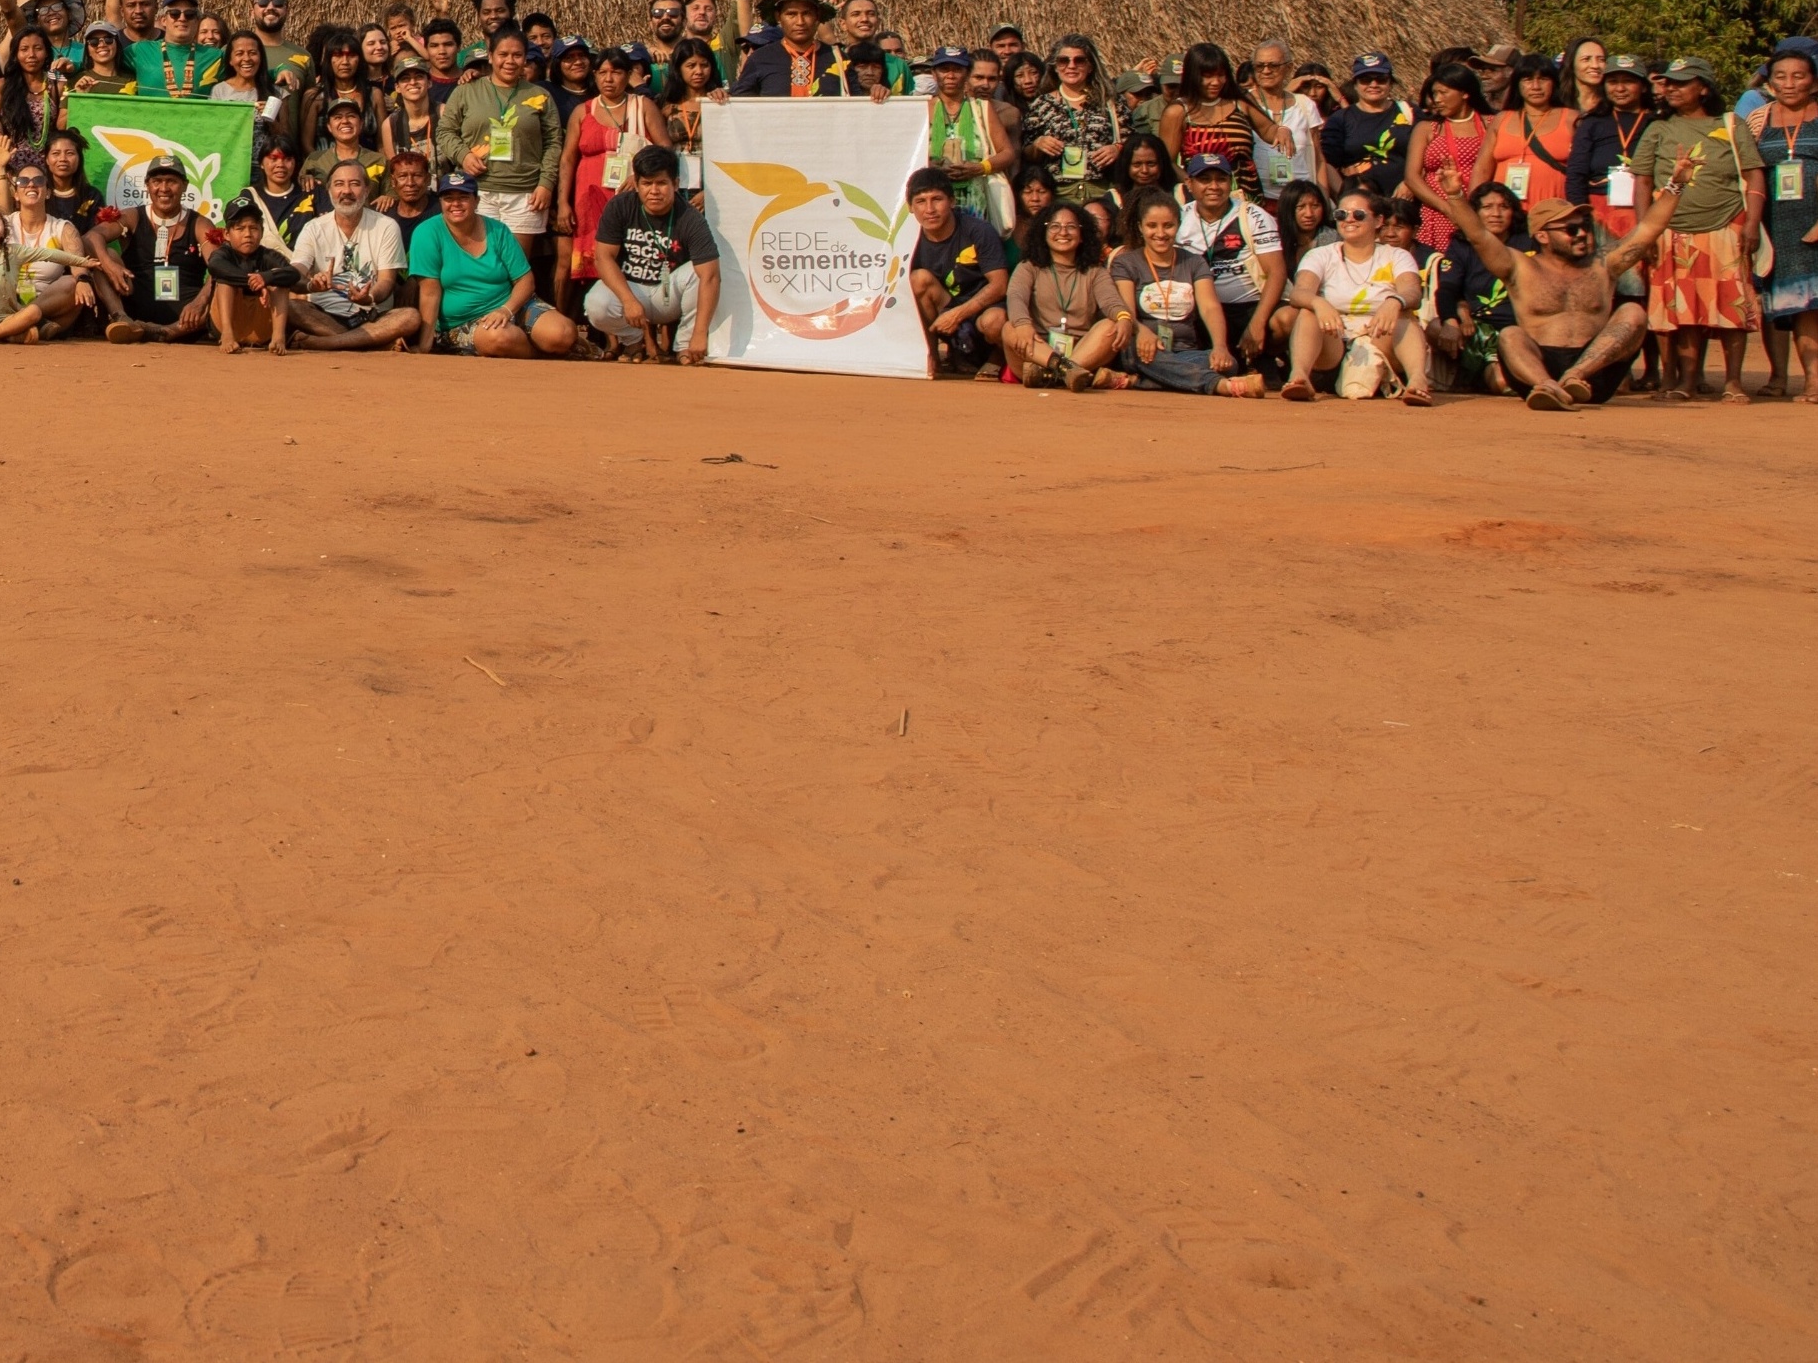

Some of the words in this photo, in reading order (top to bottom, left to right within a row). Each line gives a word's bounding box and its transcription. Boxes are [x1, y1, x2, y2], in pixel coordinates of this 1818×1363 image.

[761, 232, 828, 251] REDE
[831, 241, 848, 253] de
[762, 250, 887, 270] sementes
[763, 271, 781, 284] do
[780, 270, 886, 294] XINGU
